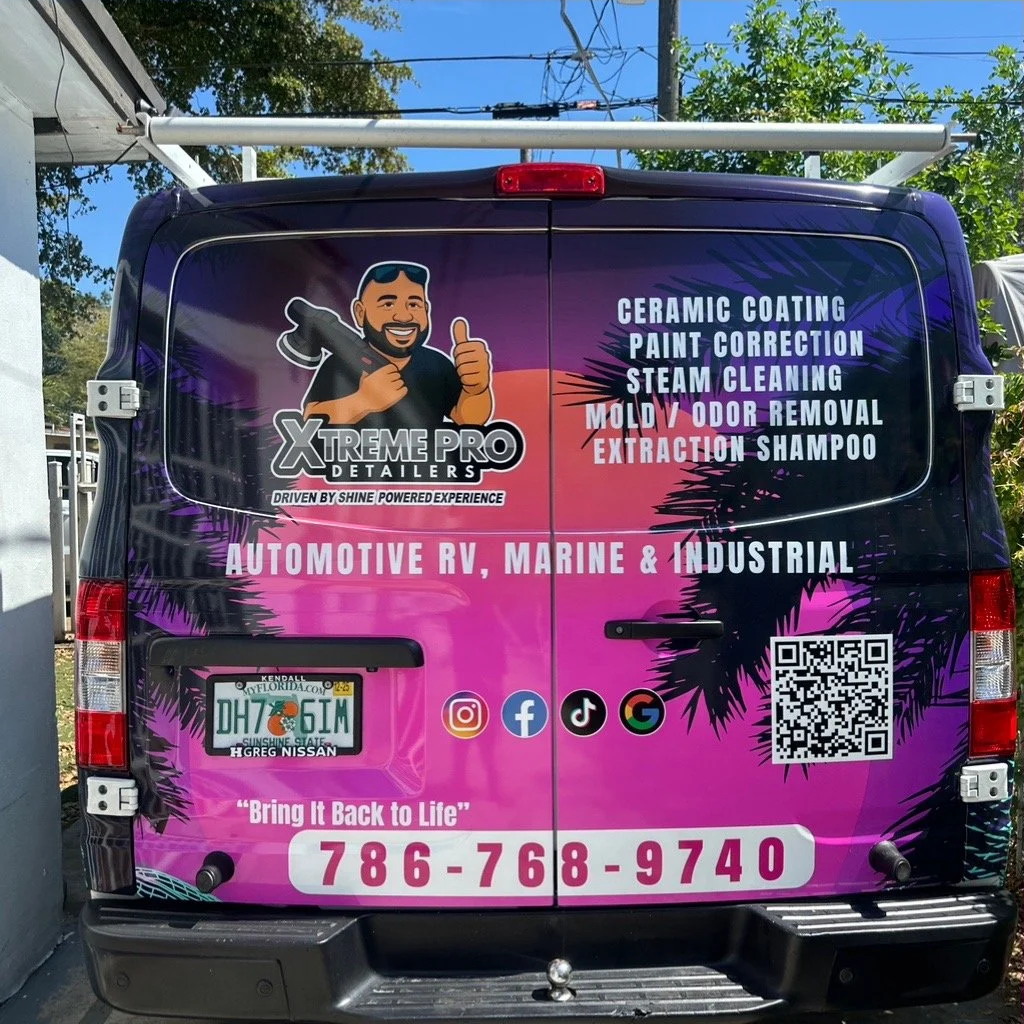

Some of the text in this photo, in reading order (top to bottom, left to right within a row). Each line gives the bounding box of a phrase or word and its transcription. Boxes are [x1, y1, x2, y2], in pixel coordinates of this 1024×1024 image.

[617, 296, 845, 325] CERAMIC COATING
[629, 330, 864, 359] PAINT CORRECTION
[626, 365, 842, 394] STEAM CLEANING
[585, 399, 883, 430] MOLD / ODOR REMOVAL
[280, 419, 517, 468] XTREME PRO
[594, 434, 877, 464] EXTRACTION SHAMPOO
[332, 464, 475, 478] DETAILERS
[274, 492, 503, 504] DRIVEN BY SHINE POWERED EXPERIENCE
[226, 541, 854, 578] AUTOMOTIVE RV, MARINE & INDUSTRIAL
[242, 682, 326, 696] MYFLORIDA.COM
[243, 737, 325, 748] SUNSHINE STATE
[282, 746, 337, 757] NISSAN
[310, 801, 326, 826] It
[331, 801, 384, 827] Back
[391, 802, 412, 827] to
[320, 837, 785, 888] 786-768-9740
